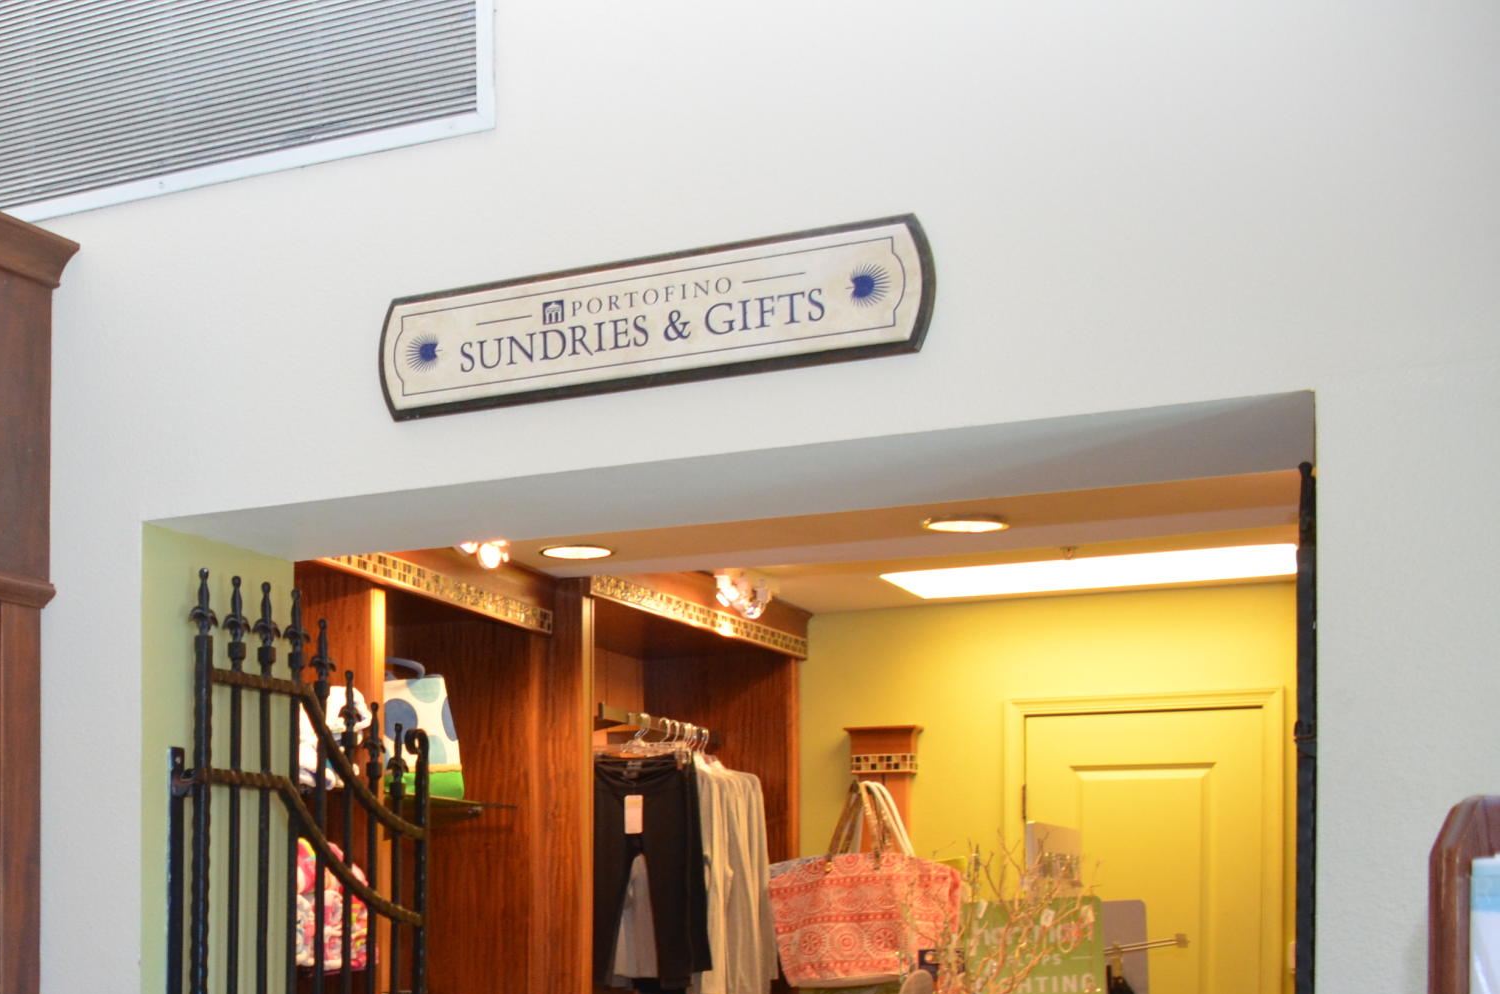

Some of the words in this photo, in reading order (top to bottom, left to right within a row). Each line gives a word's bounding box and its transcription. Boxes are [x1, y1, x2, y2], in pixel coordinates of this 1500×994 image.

[571, 277, 733, 318] PORTOFINO
[460, 314, 650, 373] SUNDRIES
[663, 309, 693, 341] &
[705, 288, 827, 335] GIFTS
